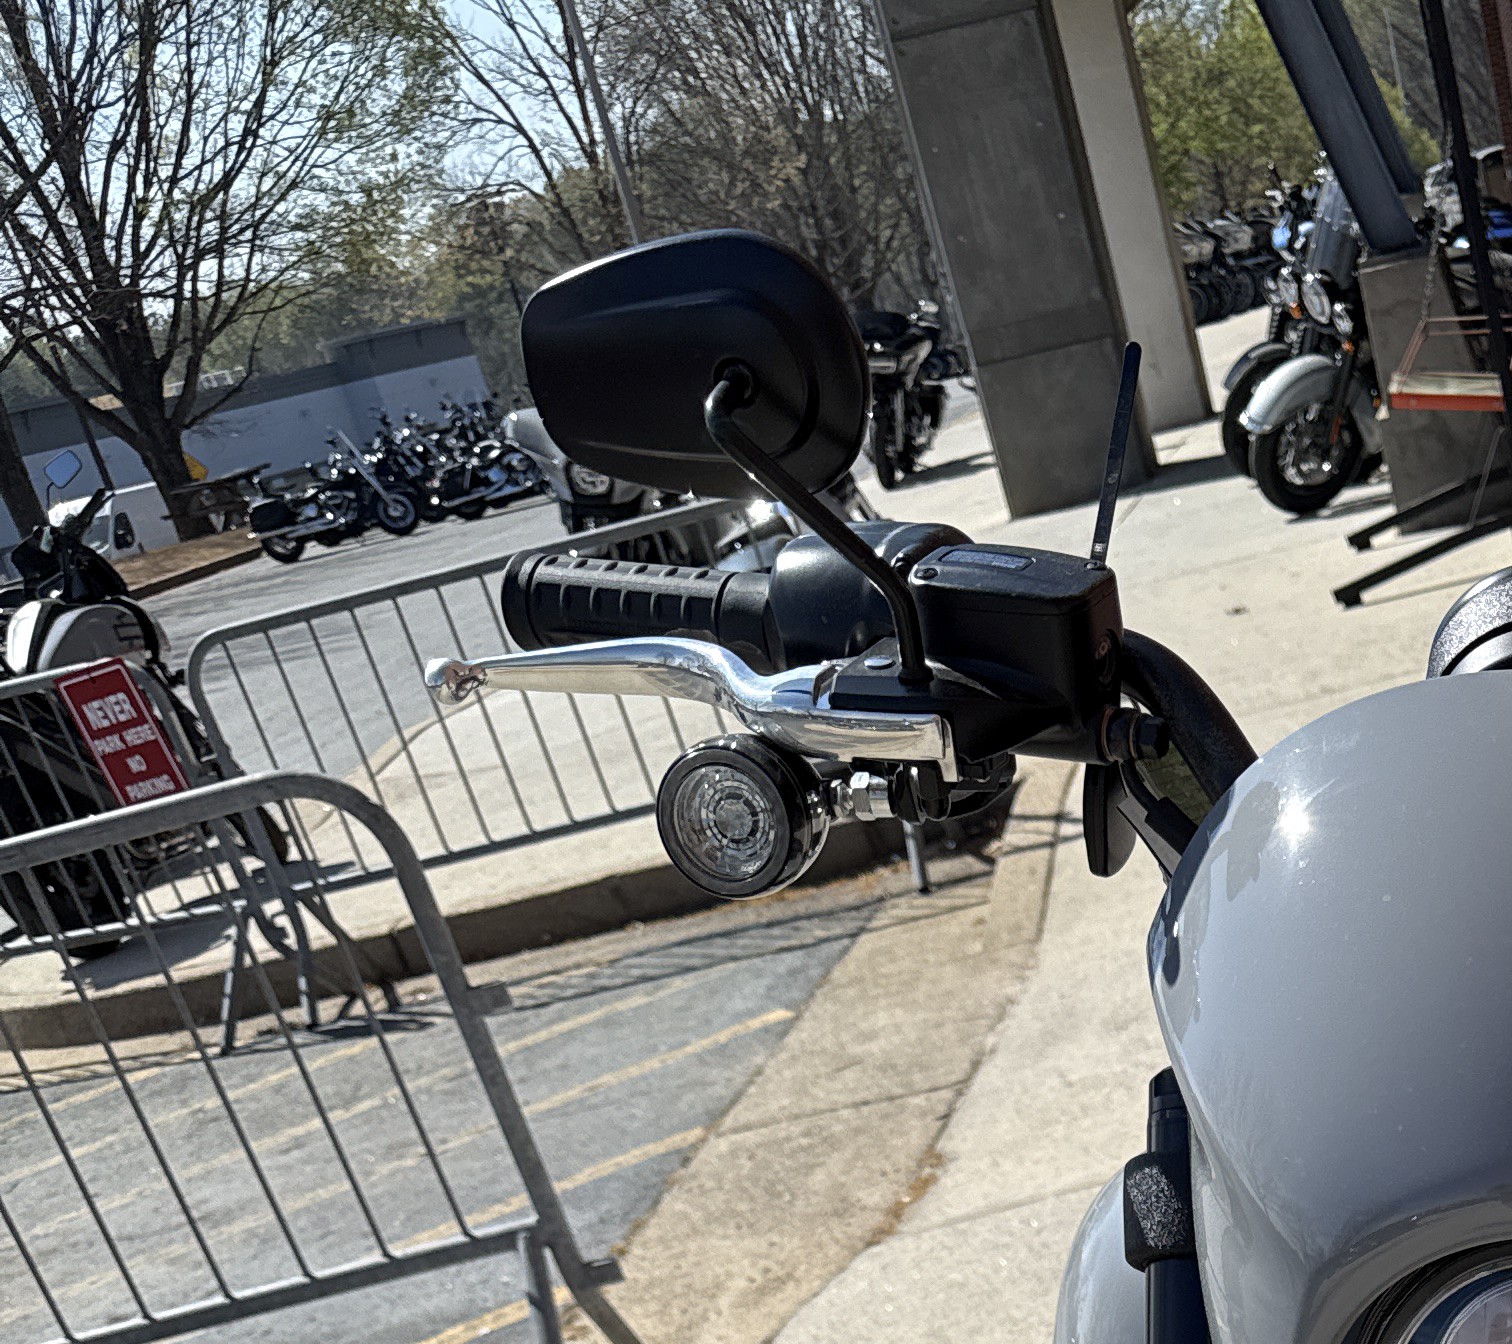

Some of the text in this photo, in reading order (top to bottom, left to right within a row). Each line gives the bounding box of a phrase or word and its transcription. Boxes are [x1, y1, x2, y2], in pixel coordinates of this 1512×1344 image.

[81, 691, 138, 731] NEVER
[94, 723, 158, 757] PARK HERE
[126, 754, 148, 774] NO
[124, 773, 176, 803] PARKING
